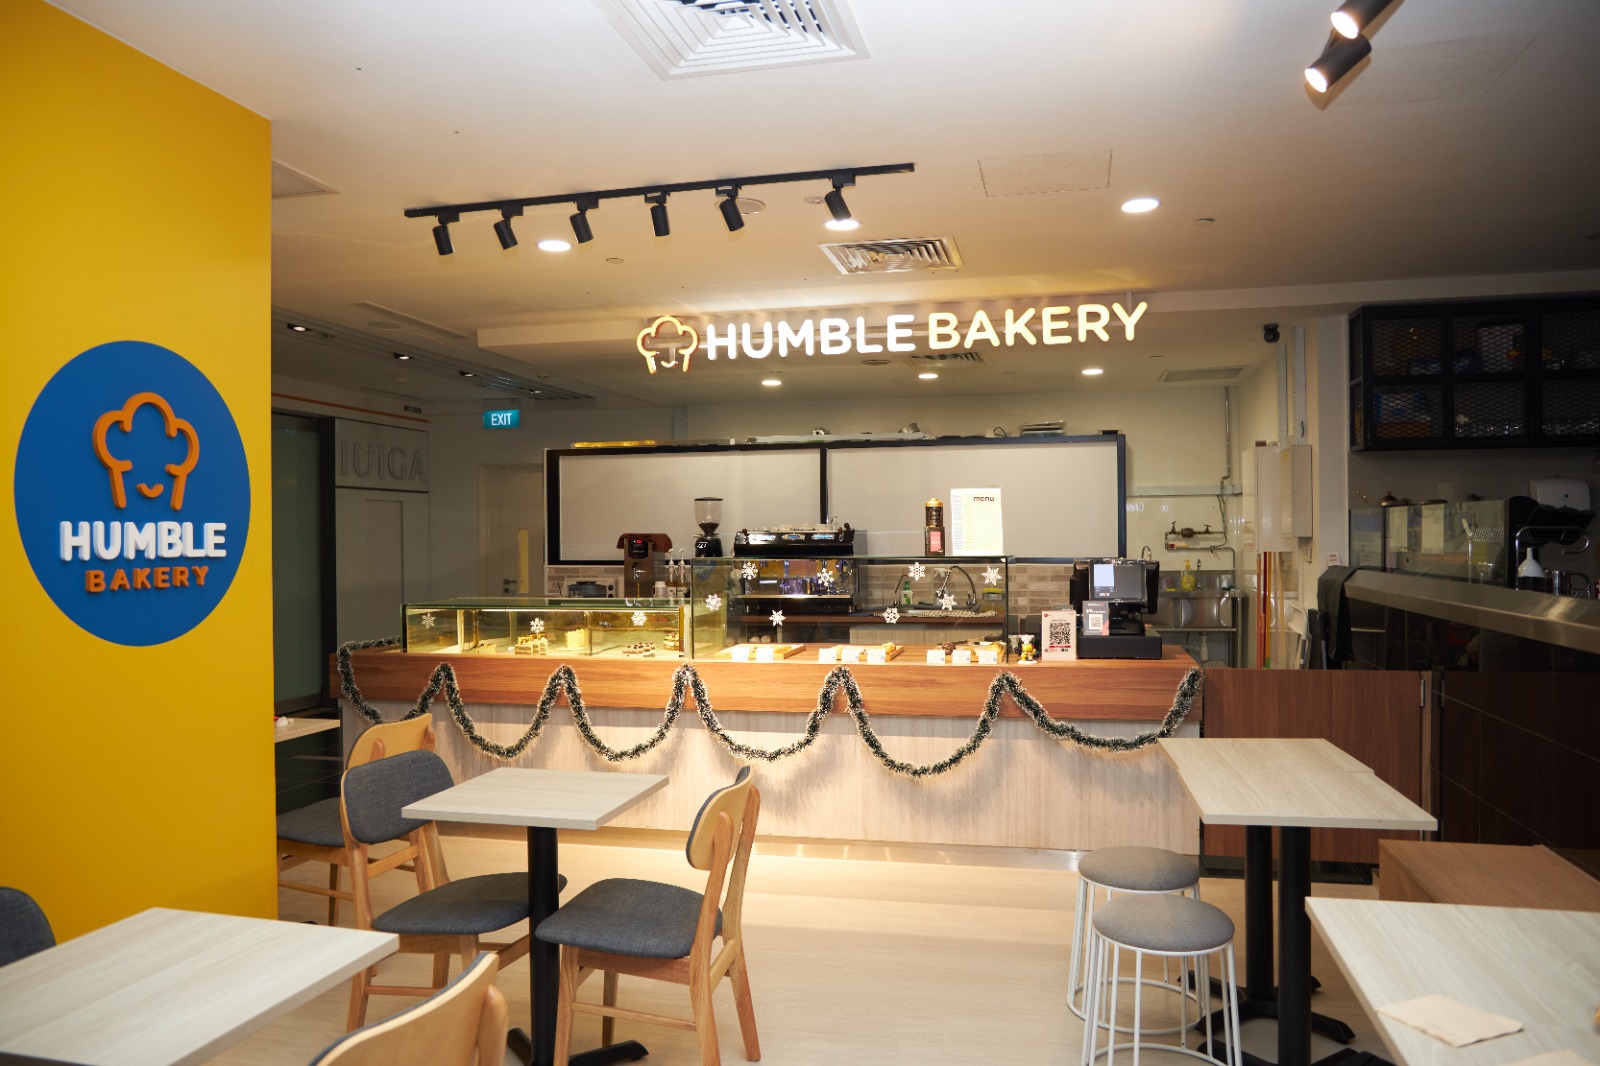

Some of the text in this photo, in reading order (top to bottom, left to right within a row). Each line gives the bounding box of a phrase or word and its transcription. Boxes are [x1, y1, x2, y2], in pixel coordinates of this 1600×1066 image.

[706, 301, 1148, 361] HUMBLE BAKERY
[491, 412, 513, 426] EXIT
[340, 440, 428, 482] IUIGA
[59, 520, 227, 562] HUMBLE
[85, 565, 209, 593] BAKERY
